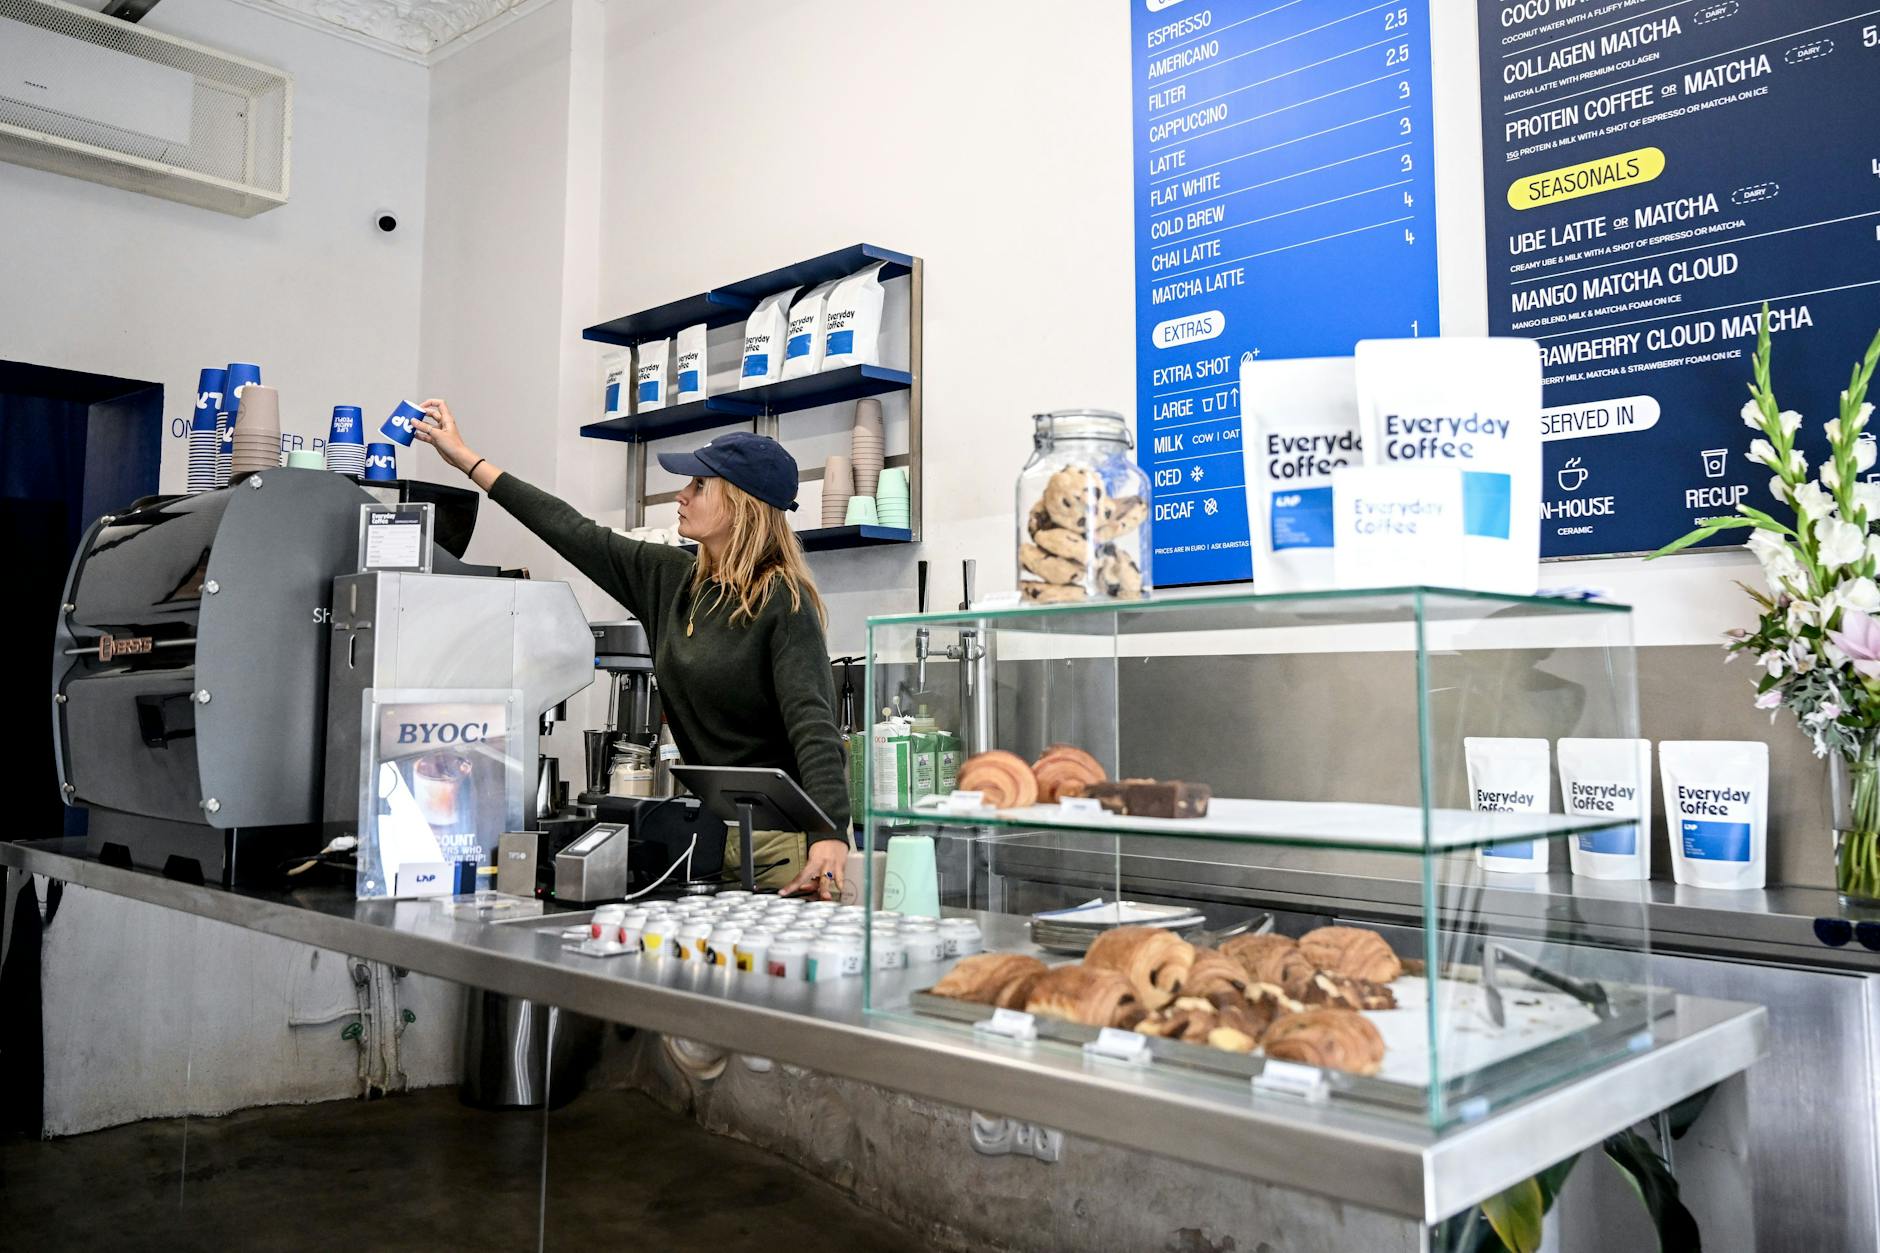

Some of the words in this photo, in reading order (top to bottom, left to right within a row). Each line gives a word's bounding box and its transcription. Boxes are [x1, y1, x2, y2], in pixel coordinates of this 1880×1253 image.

[1385, 8, 1408, 30] 2.5
[1501, 0, 1549, 27] COCO
[1502, 28, 1538, 45] COCONUT
[1539, 20, 1565, 33] WATER
[1566, 13, 1586, 26] WITH
[1594, 3, 1622, 17] FLUFFY
[1705, 7, 1727, 19] DAIRY
[1148, 10, 1212, 48] ESPRESSO
[1148, 40, 1219, 79] AMERICANO
[1386, 45, 1409, 66] 2.5
[1503, 40, 1595, 84] COLLAGEN
[1601, 15, 1682, 57] MATCHA
[1797, 46, 1821, 58] DAIRY
[1504, 88, 1534, 102] MATCHA
[1534, 81, 1558, 94] LATTE
[1558, 75, 1579, 87] WITH
[1579, 65, 1615, 80] PREMIUM
[1615, 52, 1660, 70] COLLAGEN
[1149, 85, 1186, 111] FILTER
[1399, 82, 1410, 99] 3
[1505, 105, 1579, 142] PROTEIN
[1584, 85, 1654, 121] COFFEE
[1661, 84, 1677, 96] OR
[1684, 54, 1772, 95] MATCHA
[1150, 103, 1228, 143] CAPPUCCINO
[1400, 118, 1411, 135] 3
[1506, 150, 1519, 160] 15G
[1520, 142, 1551, 156] PROTEIN
[1552, 140, 1558, 148] &
[1558, 136, 1576, 147] MILK
[1577, 130, 1598, 143] WITH
[1599, 128, 1605, 136] A
[1606, 121, 1628, 134] SHOT
[1629, 119, 1641, 128] OF
[1642, 107, 1686, 125] ESPRESSO
[1687, 103, 1700, 114] OR
[1701, 94, 1737, 110] MATCHA
[1738, 91, 1752, 101] ON
[1753, 86, 1768, 97] ICE
[1150, 150, 1186, 175] LATTE
[1401, 154, 1412, 172] 3
[1151, 184, 1178, 207] FLAT
[1182, 172, 1221, 197] WHITE
[1528, 158, 1640, 201] SEASONALS
[1404, 192, 1413, 207] 4
[1743, 188, 1766, 199] DAIRY
[1151, 214, 1184, 239] COLD
[1187, 204, 1225, 230] BREW
[1509, 229, 1546, 255] UBE
[1551, 217, 1607, 246] LATTE
[1613, 217, 1628, 228] OR
[1635, 193, 1719, 229] MATCHA
[1405, 229, 1414, 244] 4
[1510, 261, 1541, 273] CREAMY
[1542, 257, 1557, 266] UBE
[1565, 252, 1583, 262] MILK
[1584, 247, 1605, 259] WITH
[1605, 246, 1612, 254] A
[1612, 241, 1634, 253] SHOT
[1636, 239, 1648, 248] OF
[1649, 230, 1693, 245] ESPRESSO
[1694, 226, 1707, 235] OR
[1709, 219, 1745, 233] MATCHA
[1151, 250, 1180, 272] CHAI
[1184, 239, 1221, 264] LATTE
[1152, 278, 1203, 305] MATCHA
[1206, 268, 1245, 292] LATTE
[1512, 283, 1577, 313] MANGO
[1583, 267, 1663, 300] MATCHA
[1668, 252, 1738, 281] CLOUD
[789, 315, 814, 328] veryday
[827, 309, 855, 322] Everyday
[1512, 319, 1541, 330] MANGO
[1541, 313, 1568, 325] BLEND,
[1569, 310, 1586, 320] MILK
[1594, 304, 1628, 316] MATCHA
[1628, 299, 1653, 311] FOAM
[1654, 297, 1667, 306] ON
[1668, 294, 1682, 303] ICE
[788, 325, 804, 336] offee
[1164, 317, 1212, 343] EXTRAS
[1411, 320, 1419, 338] 1
[1539, 333, 1641, 368] RAWBERRY
[1646, 321, 1715, 351] CLOUD
[1721, 306, 1813, 340] MATCHA
[679, 351, 699, 362] veryday
[745, 343, 760, 353] offee
[638, 364, 660, 374] veryday
[1153, 363, 1193, 387] EXTRA
[1196, 355, 1231, 378] SHOT
[1541, 375, 1565, 386] BERRY
[1566, 371, 1586, 382] MILK,
[1586, 367, 1619, 379] MATCHA
[1627, 358, 1684, 373] STRAWBERRY
[1685, 354, 1710, 365] FOAM
[1712, 352, 1725, 361] ON
[1727, 349, 1742, 358] ICE
[1154, 399, 1193, 421] LARGE
[1541, 409, 1609, 435] SERVED
[1616, 405, 1634, 426] IN
[1386, 413, 1510, 439] Everyday
[1154, 433, 1184, 454] MILK
[1192, 432, 1214, 445] COW
[1222, 428, 1241, 440] OAT
[1387, 438, 1474, 461] Coffee
[1154, 467, 1182, 488] ICED
[1354, 499, 1443, 517] Everyday
[1540, 496, 1615, 519] N-HOUSE
[1685, 485, 1749, 509] RECUP
[1155, 500, 1195, 521] DECAF
[1355, 518, 1417, 536] Coffee
[1557, 525, 1593, 536] CERAMIC
[1154, 546, 1174, 555] PRICES
[1191, 544, 1206, 552] EURO
[1222, 540, 1249, 549] BARISTAS
[397, 722, 489, 745] BYOC!
[1477, 789, 1534, 806] Everyday
[1572, 782, 1635, 801] Everyday
[1678, 786, 1751, 803] Everyday
[1573, 796, 1615, 812] Coffee
[1680, 800, 1729, 816] Coffee
